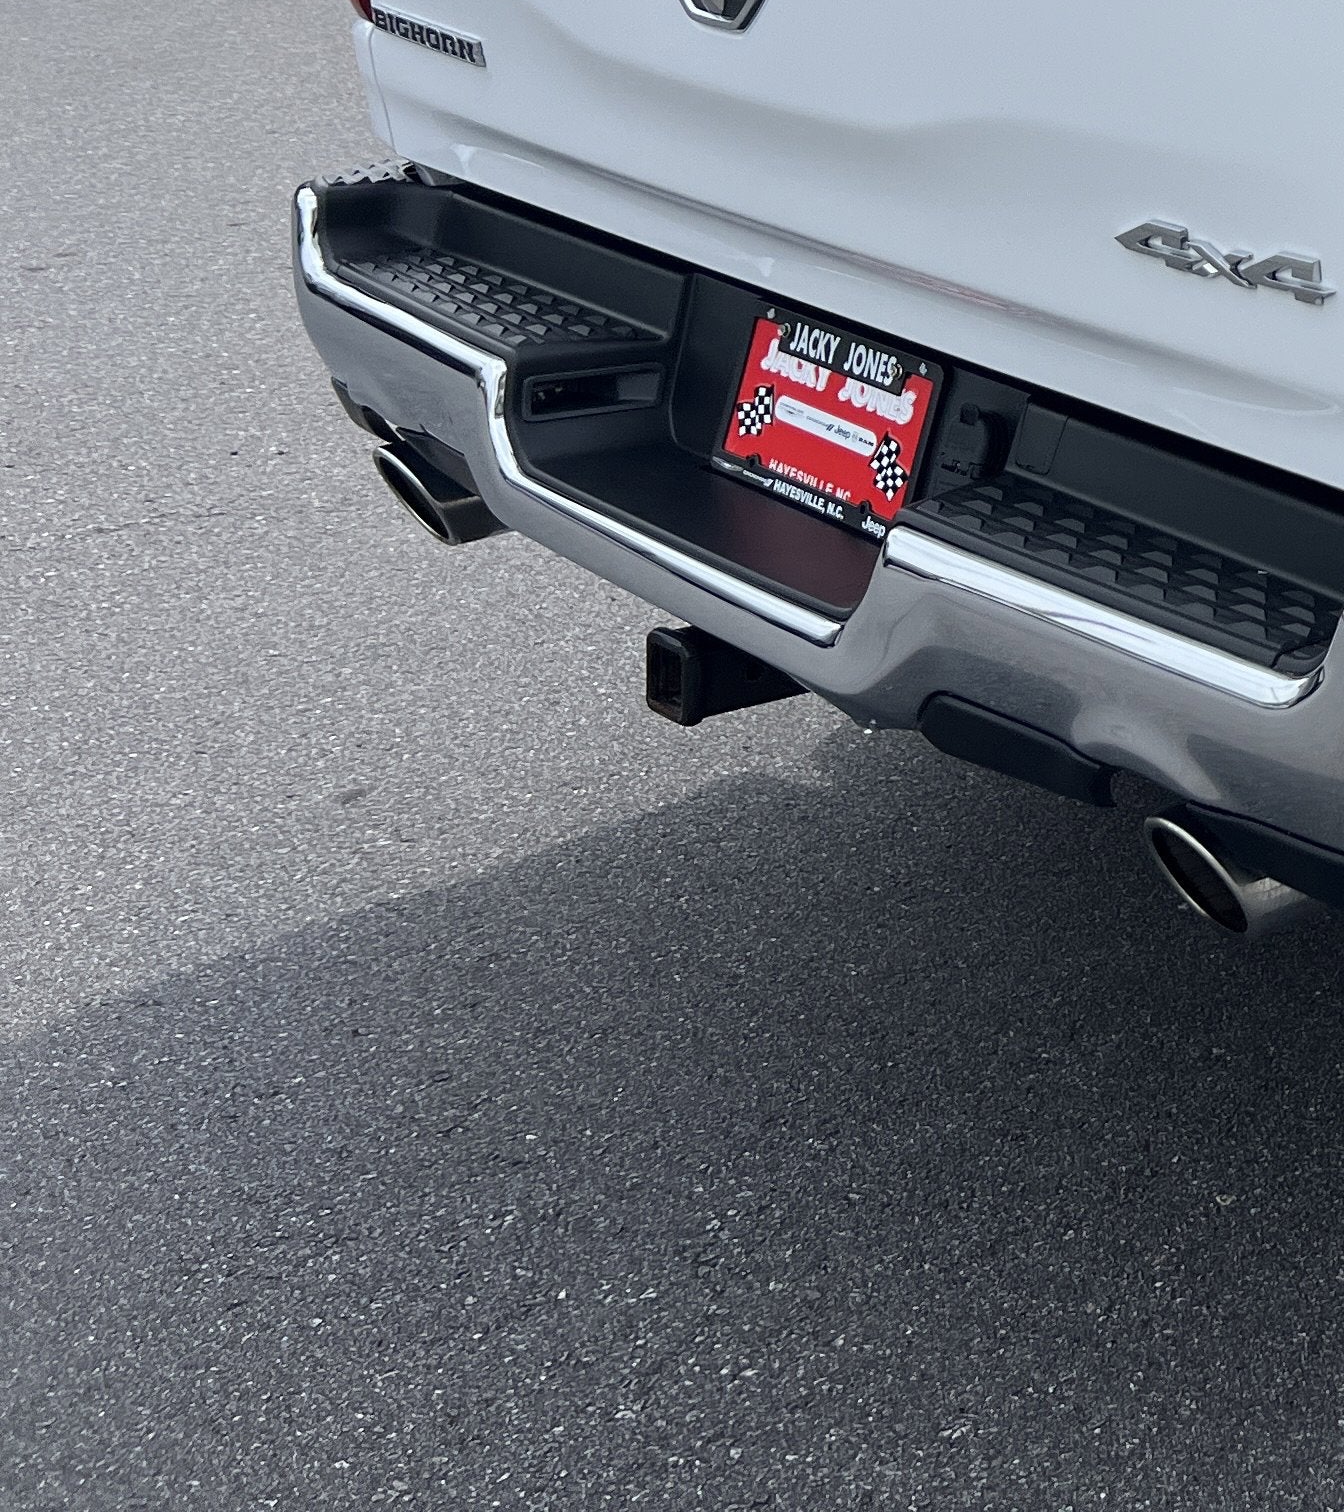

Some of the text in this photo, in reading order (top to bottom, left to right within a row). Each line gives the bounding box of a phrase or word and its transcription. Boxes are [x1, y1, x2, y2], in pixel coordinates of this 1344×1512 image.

[371, 6, 483, 66] BIGHORN
[789, 322, 898, 386] JACKY JONES
[861, 515, 886, 539] Jeep
